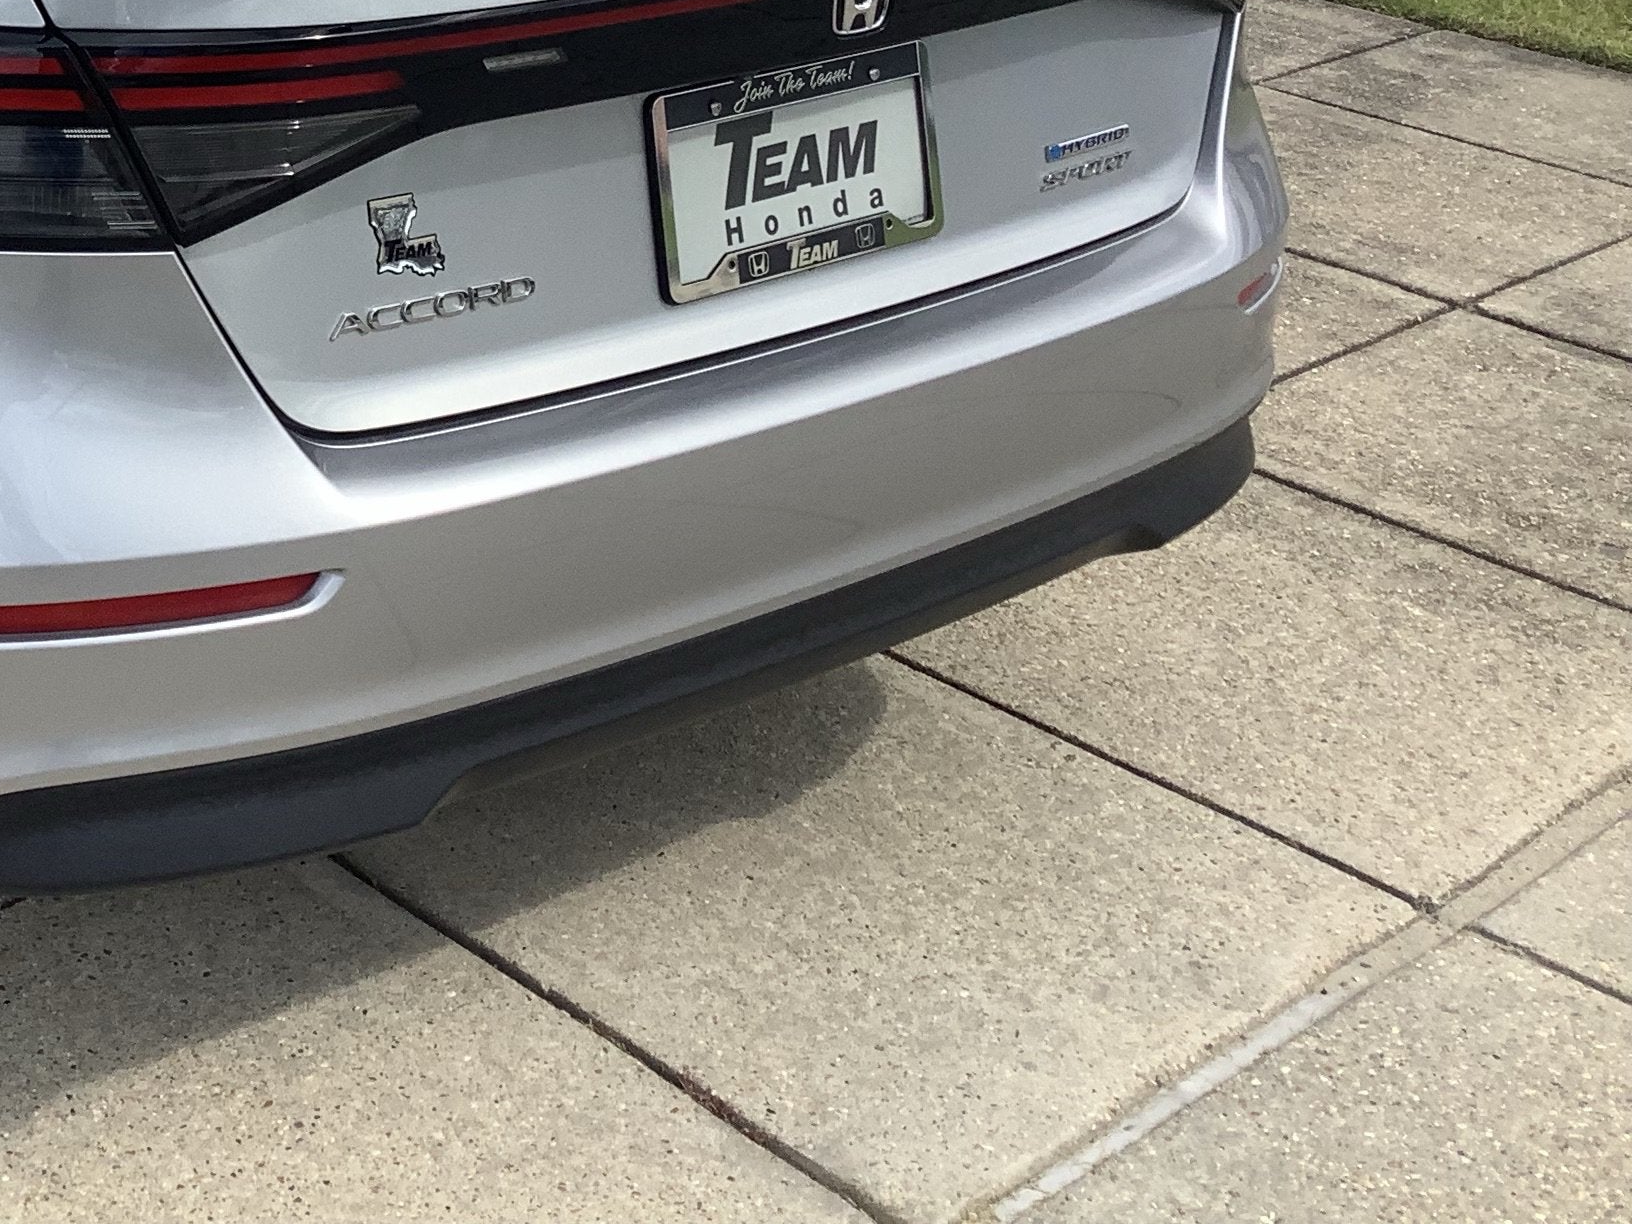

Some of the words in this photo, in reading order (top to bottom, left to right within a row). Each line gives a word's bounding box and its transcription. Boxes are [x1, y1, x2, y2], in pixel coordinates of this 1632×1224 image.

[733, 79, 774, 114] Join
[774, 71, 806, 96] The
[805, 60, 856, 89] Team!
[713, 110, 879, 211] TEAM
[1061, 126, 1129, 157] HYBRID
[1039, 149, 1134, 193] SPORT
[724, 186, 885, 247] Honda
[383, 238, 433, 264] TEAM
[786, 237, 839, 271] TEAM
[329, 275, 536, 342] ACCORD
